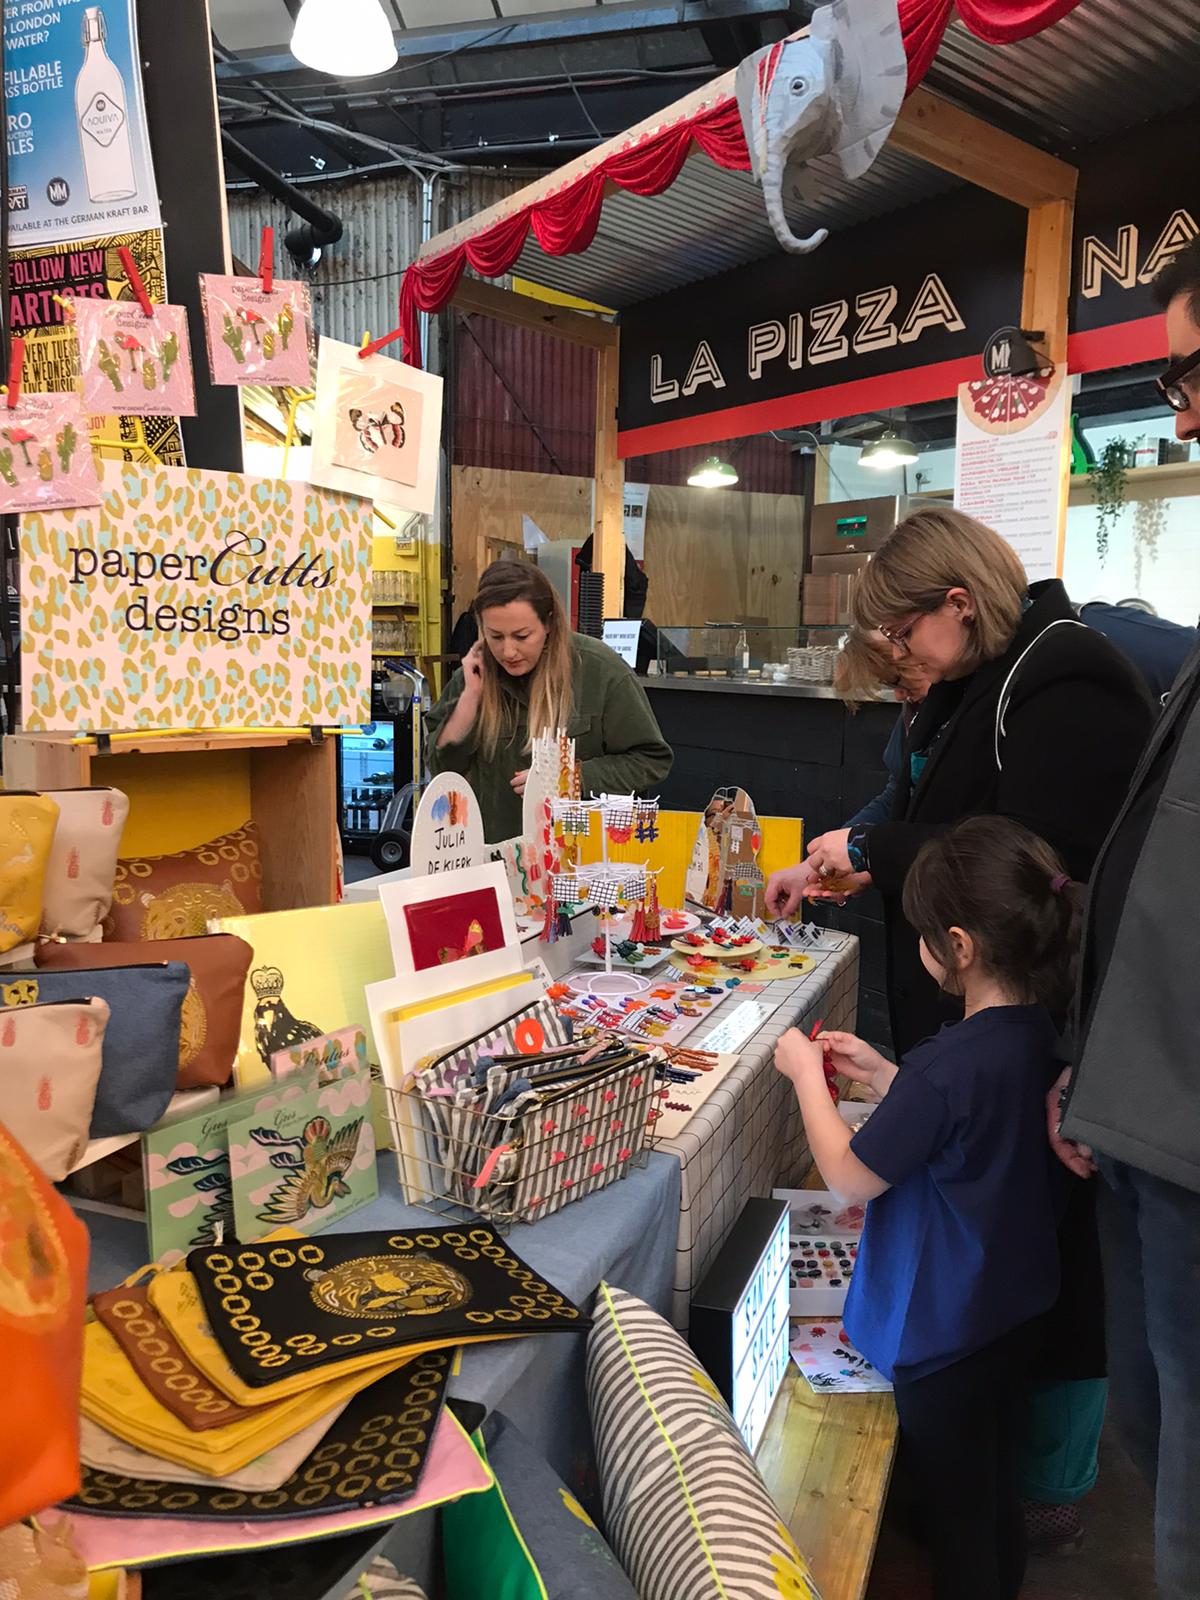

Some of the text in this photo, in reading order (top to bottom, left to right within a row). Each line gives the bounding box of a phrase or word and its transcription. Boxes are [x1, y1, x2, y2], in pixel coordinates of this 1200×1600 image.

[21, 0, 54, 15] FROM
[10, 12, 61, 33] LONDON
[6, 31, 50, 50] WATER?
[22, 76, 64, 95] BOTTLE
[8, 112, 32, 131] RO
[7, 138, 34, 156] ILES
[43, 219, 52, 228] AT
[54, 216, 70, 227] THE
[71, 211, 105, 225] GERMAN
[106, 207, 131, 219] KRAFT
[132, 204, 150, 216] BAR
[69, 250, 104, 277] NEW
[651, 340, 727, 404] LA
[749, 273, 967, 380] PIZZA
[24, 341, 49, 364] VERY
[69, 530, 337, 588] paperCutts
[125, 596, 290, 641] designs
[434, 827, 465, 850] JULIA
[745, 1225, 786, 1339] SAMPLE
[752, 1297, 777, 1381] SALE
